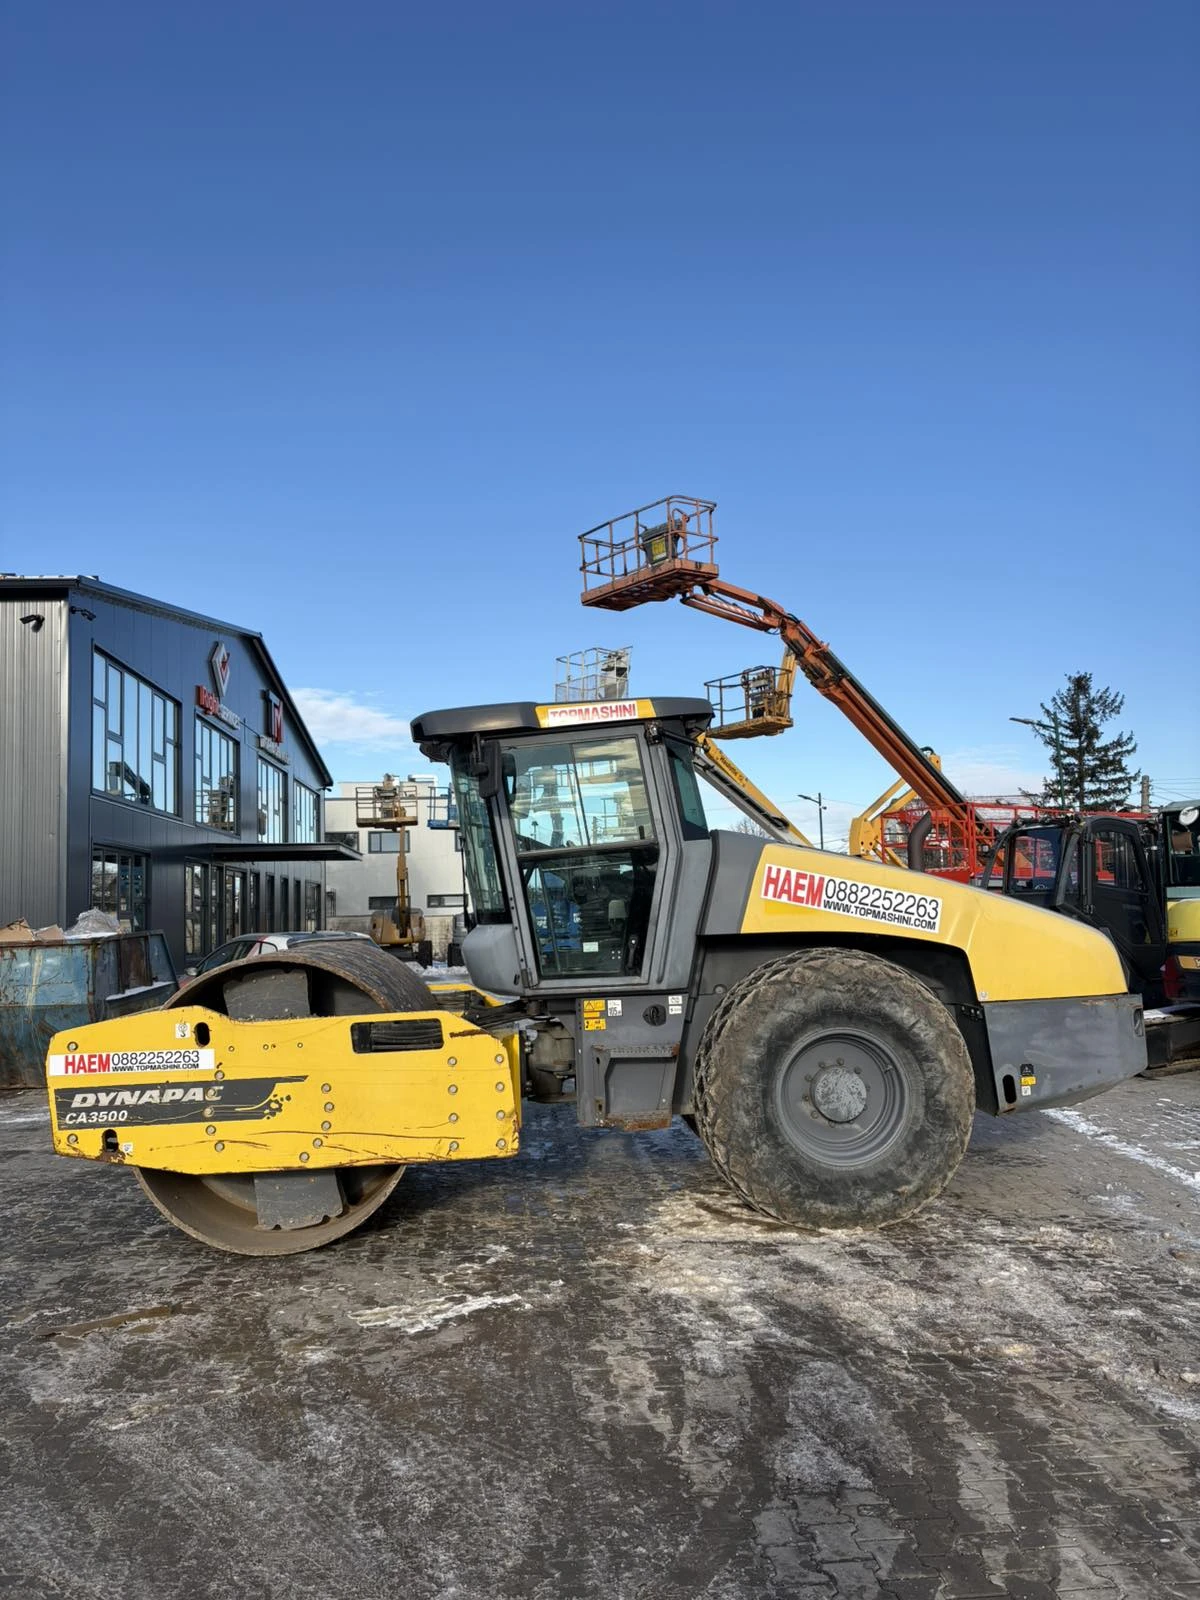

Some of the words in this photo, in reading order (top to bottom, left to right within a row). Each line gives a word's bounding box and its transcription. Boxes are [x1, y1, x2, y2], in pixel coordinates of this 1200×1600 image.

[825, 878, 938, 920] 0882252263
[823, 899, 936, 931] WWW.TOPMASHINI.COM
[111, 1050, 200, 1066] 0882252263
[112, 1063, 199, 1072] WWW.TOPMASHINI.COM
[71, 1086, 224, 1108] DYNAPAC
[65, 1110, 128, 1125] CA3500
